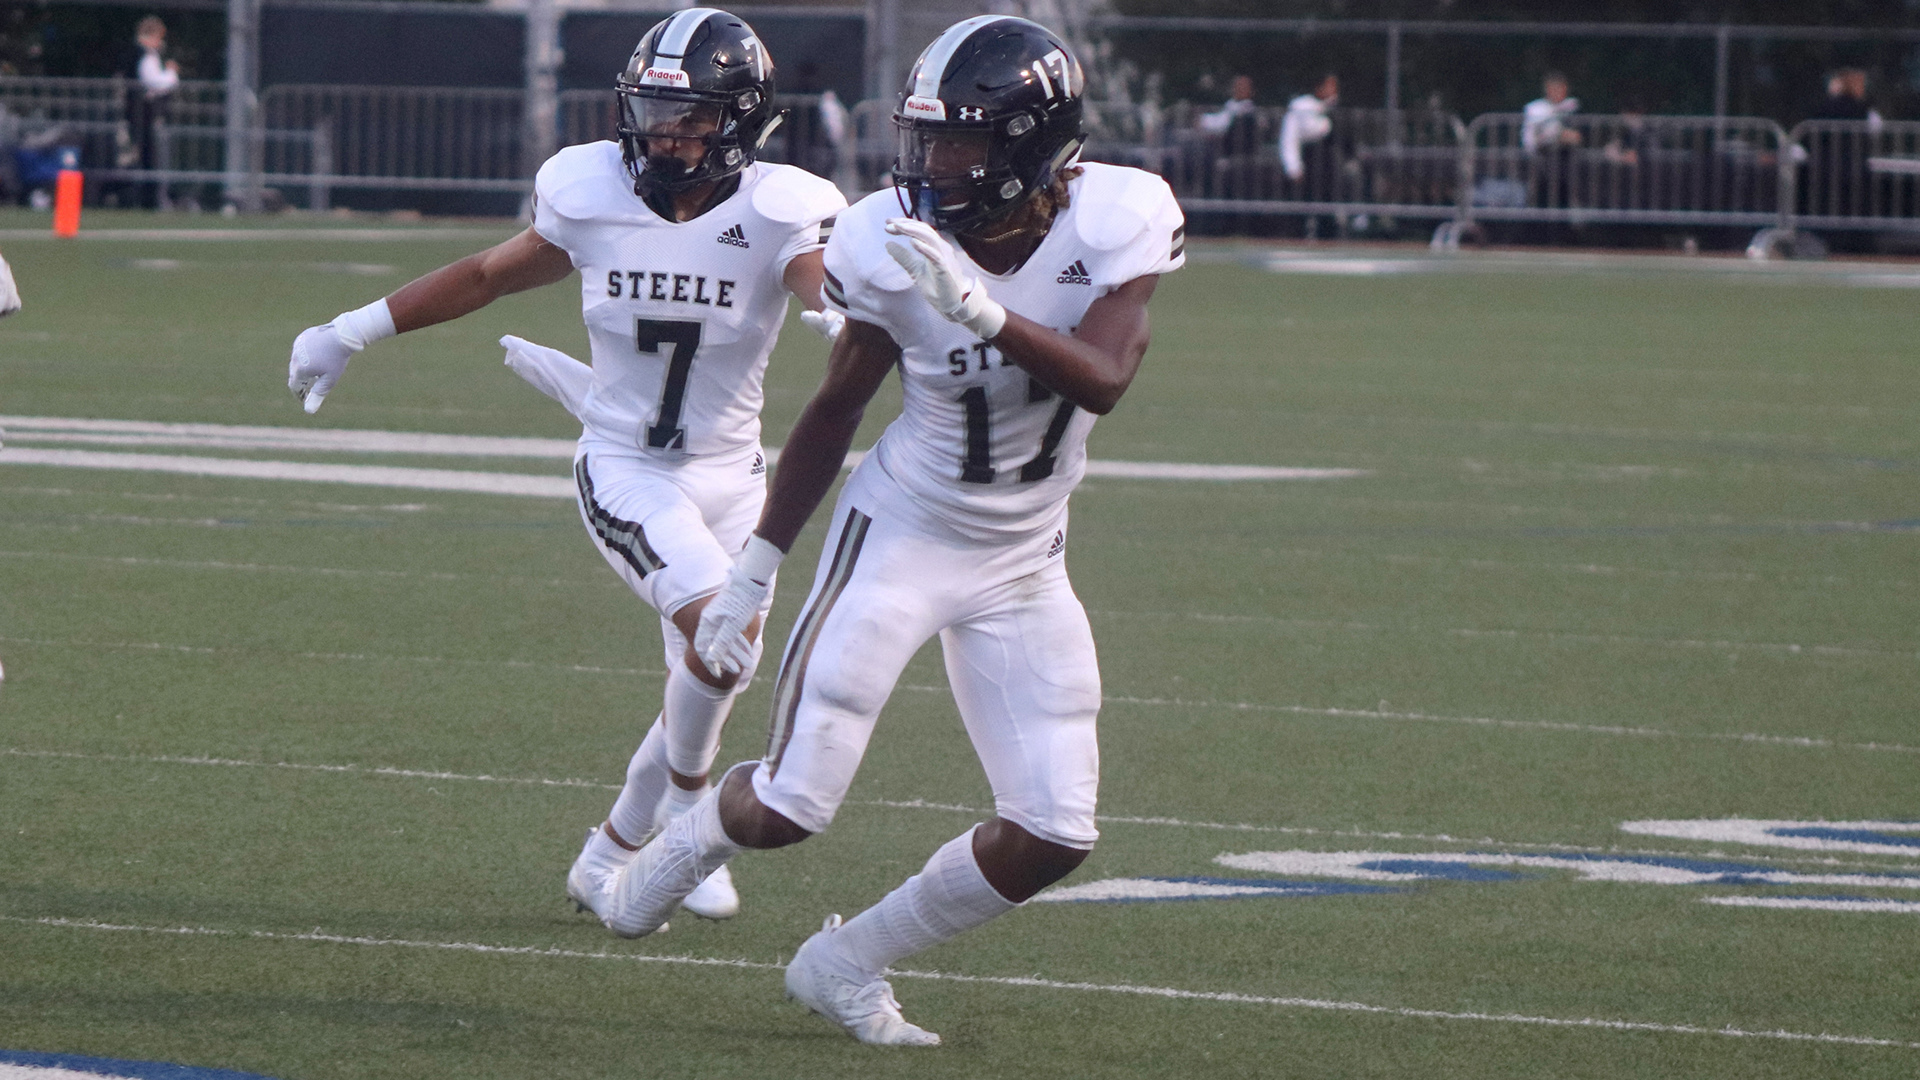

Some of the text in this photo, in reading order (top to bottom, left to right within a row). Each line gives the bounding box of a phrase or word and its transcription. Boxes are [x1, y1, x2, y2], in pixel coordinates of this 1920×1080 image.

[647, 69, 683, 81] Riddell
[740, 35, 765, 82] 7
[1032, 48, 1072, 100] 17
[717, 234, 750, 249] adidas
[607, 269, 736, 308] STEELE
[1056, 275, 1092, 286] adidas
[634, 315, 706, 450] 7
[954, 374, 1078, 485] 17
